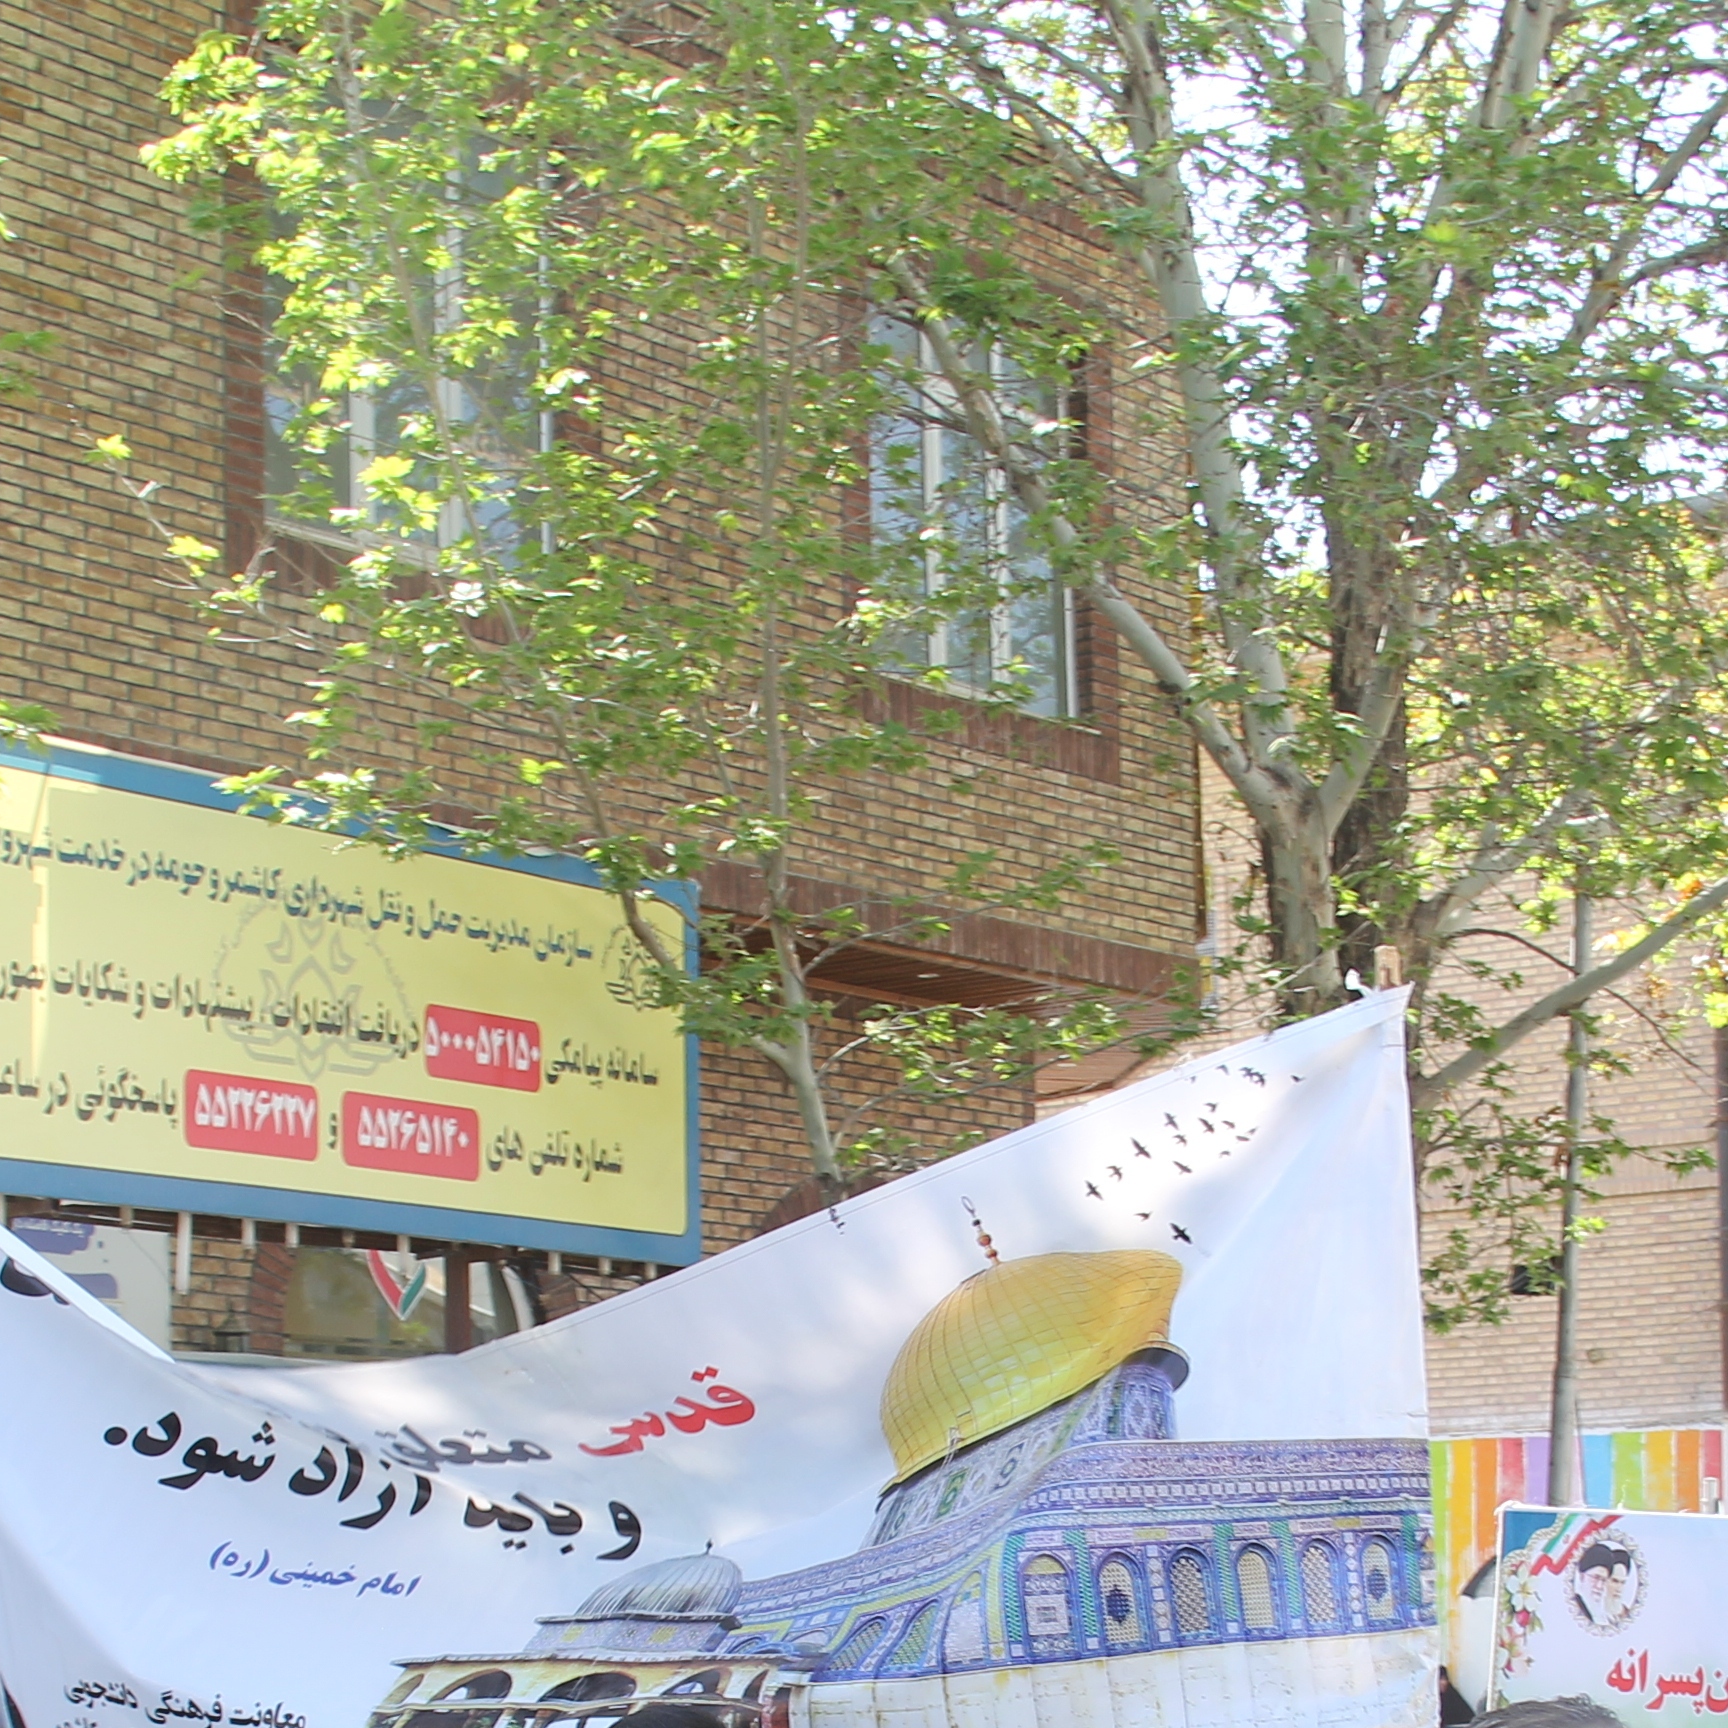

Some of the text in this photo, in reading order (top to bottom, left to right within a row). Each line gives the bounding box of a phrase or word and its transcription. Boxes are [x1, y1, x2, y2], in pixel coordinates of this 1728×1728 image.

[56, 838, 125, 871] خدمت
[126, 850, 152, 886] در
[154, 854, 205, 895] حومه
[207, 867, 220, 899] و
[220, 866, 282, 902] کاشمر
[285, 875, 363, 926] شهرداری
[368, 889, 401, 930] نقل
[404, 905, 415, 935] و
[417, 899, 462, 939] حمل
[465, 914, 530, 952] مدیریت
[532, 923, 592, 967] سازمان
[52, 958, 129, 1007] شکایات
[132, 979, 144, 1019] و
[149, 972, 254, 1034] پیشنهادات
[357, 1002, 420, 1059] دریافت
[606, 1046, 659, 1085] سامانه
[43, 1072, 69, 1115] در
[328, 1112, 337, 1149] و
[485, 1126, 523, 1173] های
[528, 1129, 569, 1176] تلفن
[574, 1137, 624, 1182] شماره
[577, 1365, 756, 1457] قدس
[596, 1500, 642, 1561] و
[269, 1561, 358, 1589] خمینی
[357, 1571, 422, 1598] امام
[1606, 1647, 1704, 1715] پسرانه
